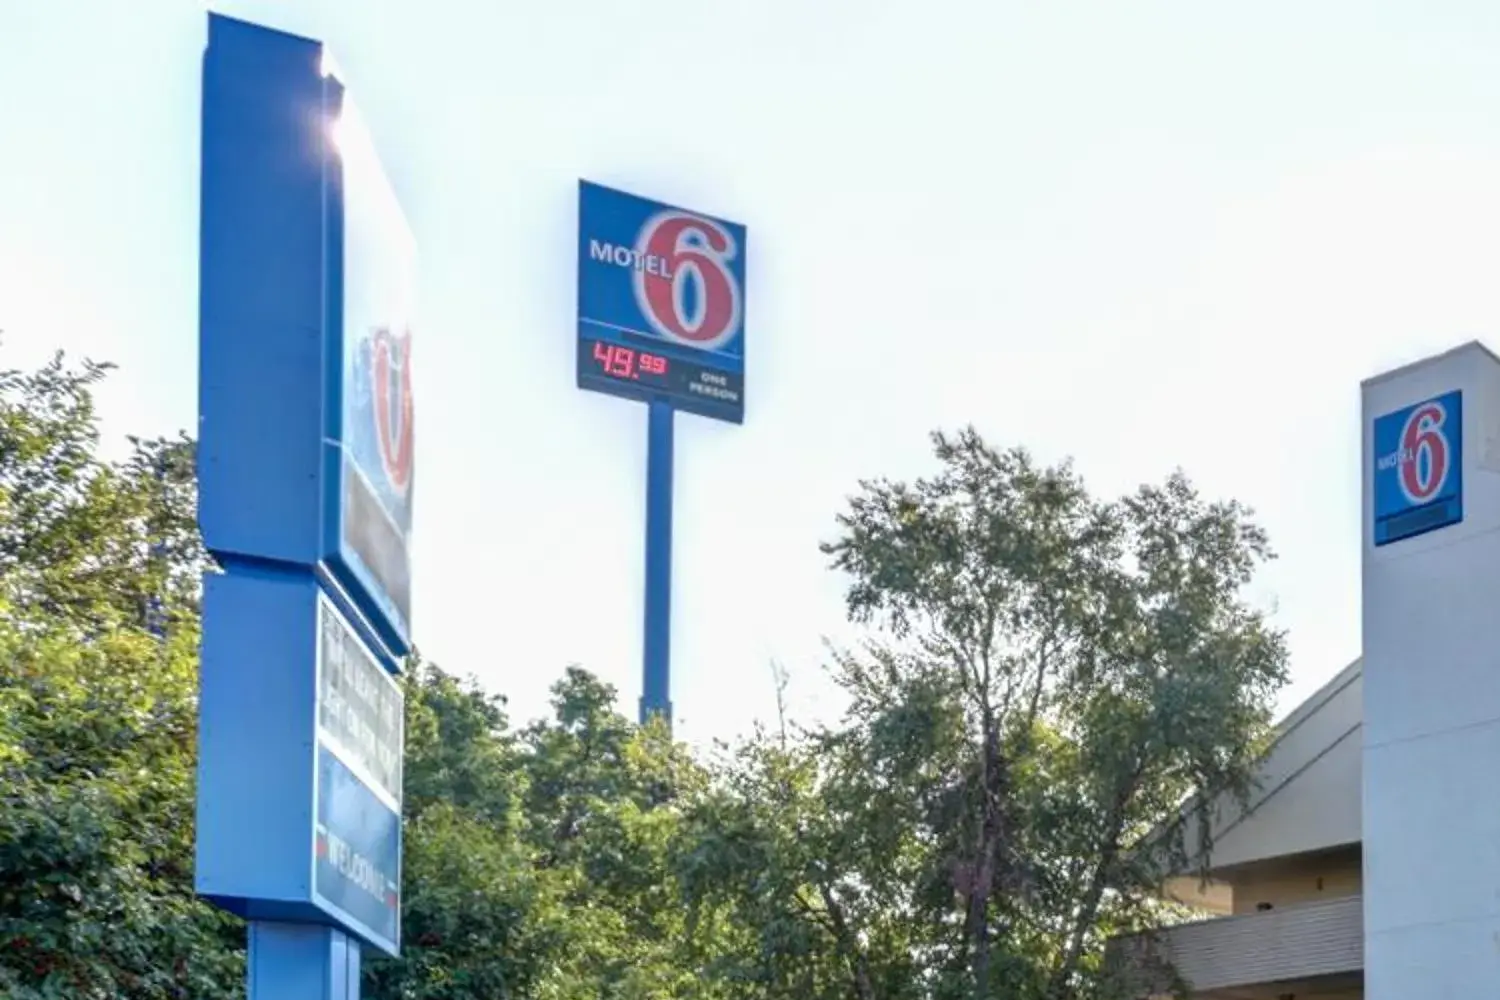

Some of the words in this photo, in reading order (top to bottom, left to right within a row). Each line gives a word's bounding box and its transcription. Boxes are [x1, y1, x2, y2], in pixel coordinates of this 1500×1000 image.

[590, 239, 672, 279] MOTEL
[632, 209, 739, 348] 6
[689, 382, 738, 400] PERSON
[1399, 402, 1450, 504] 6
